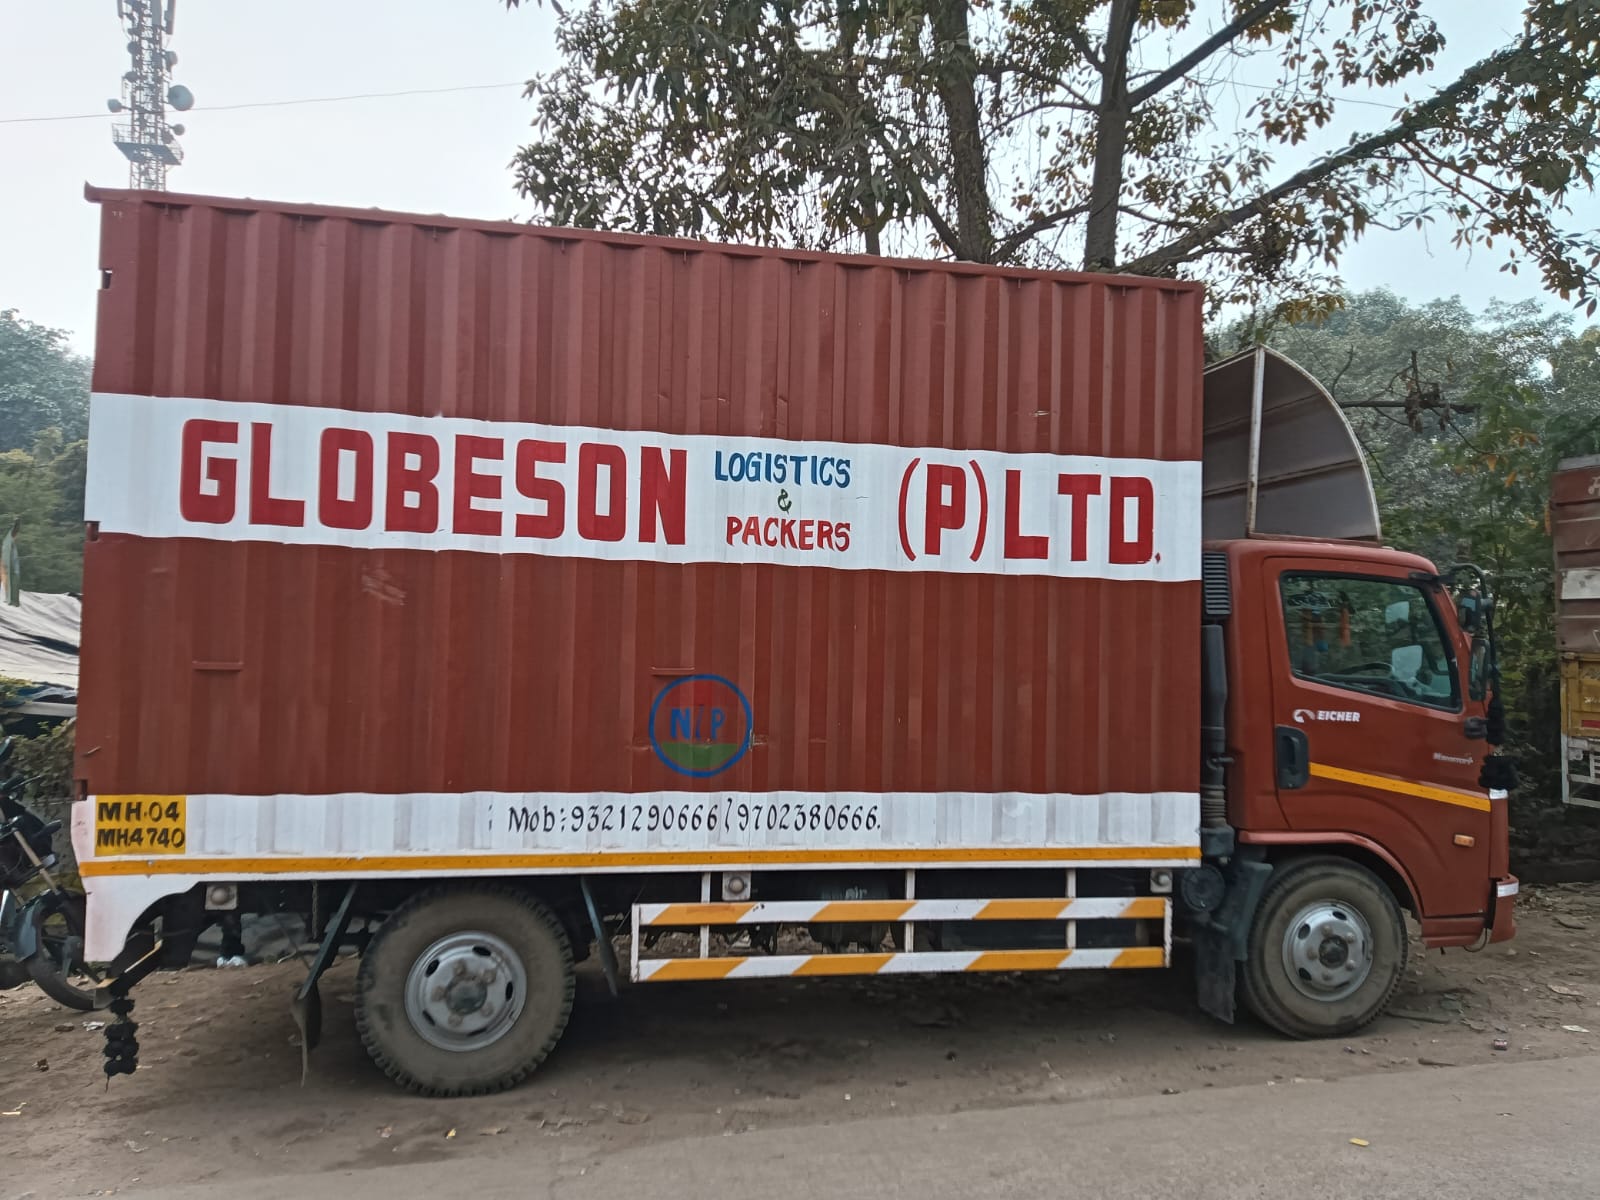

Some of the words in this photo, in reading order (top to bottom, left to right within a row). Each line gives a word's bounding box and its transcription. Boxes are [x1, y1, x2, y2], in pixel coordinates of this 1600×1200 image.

[180, 418, 688, 546] GLOBESON
[714, 450, 851, 489] LOGISTICS
[777, 488, 793, 514] &
[726, 516, 851, 552] PACKERS
[1316, 710, 1361, 723] EICHER
